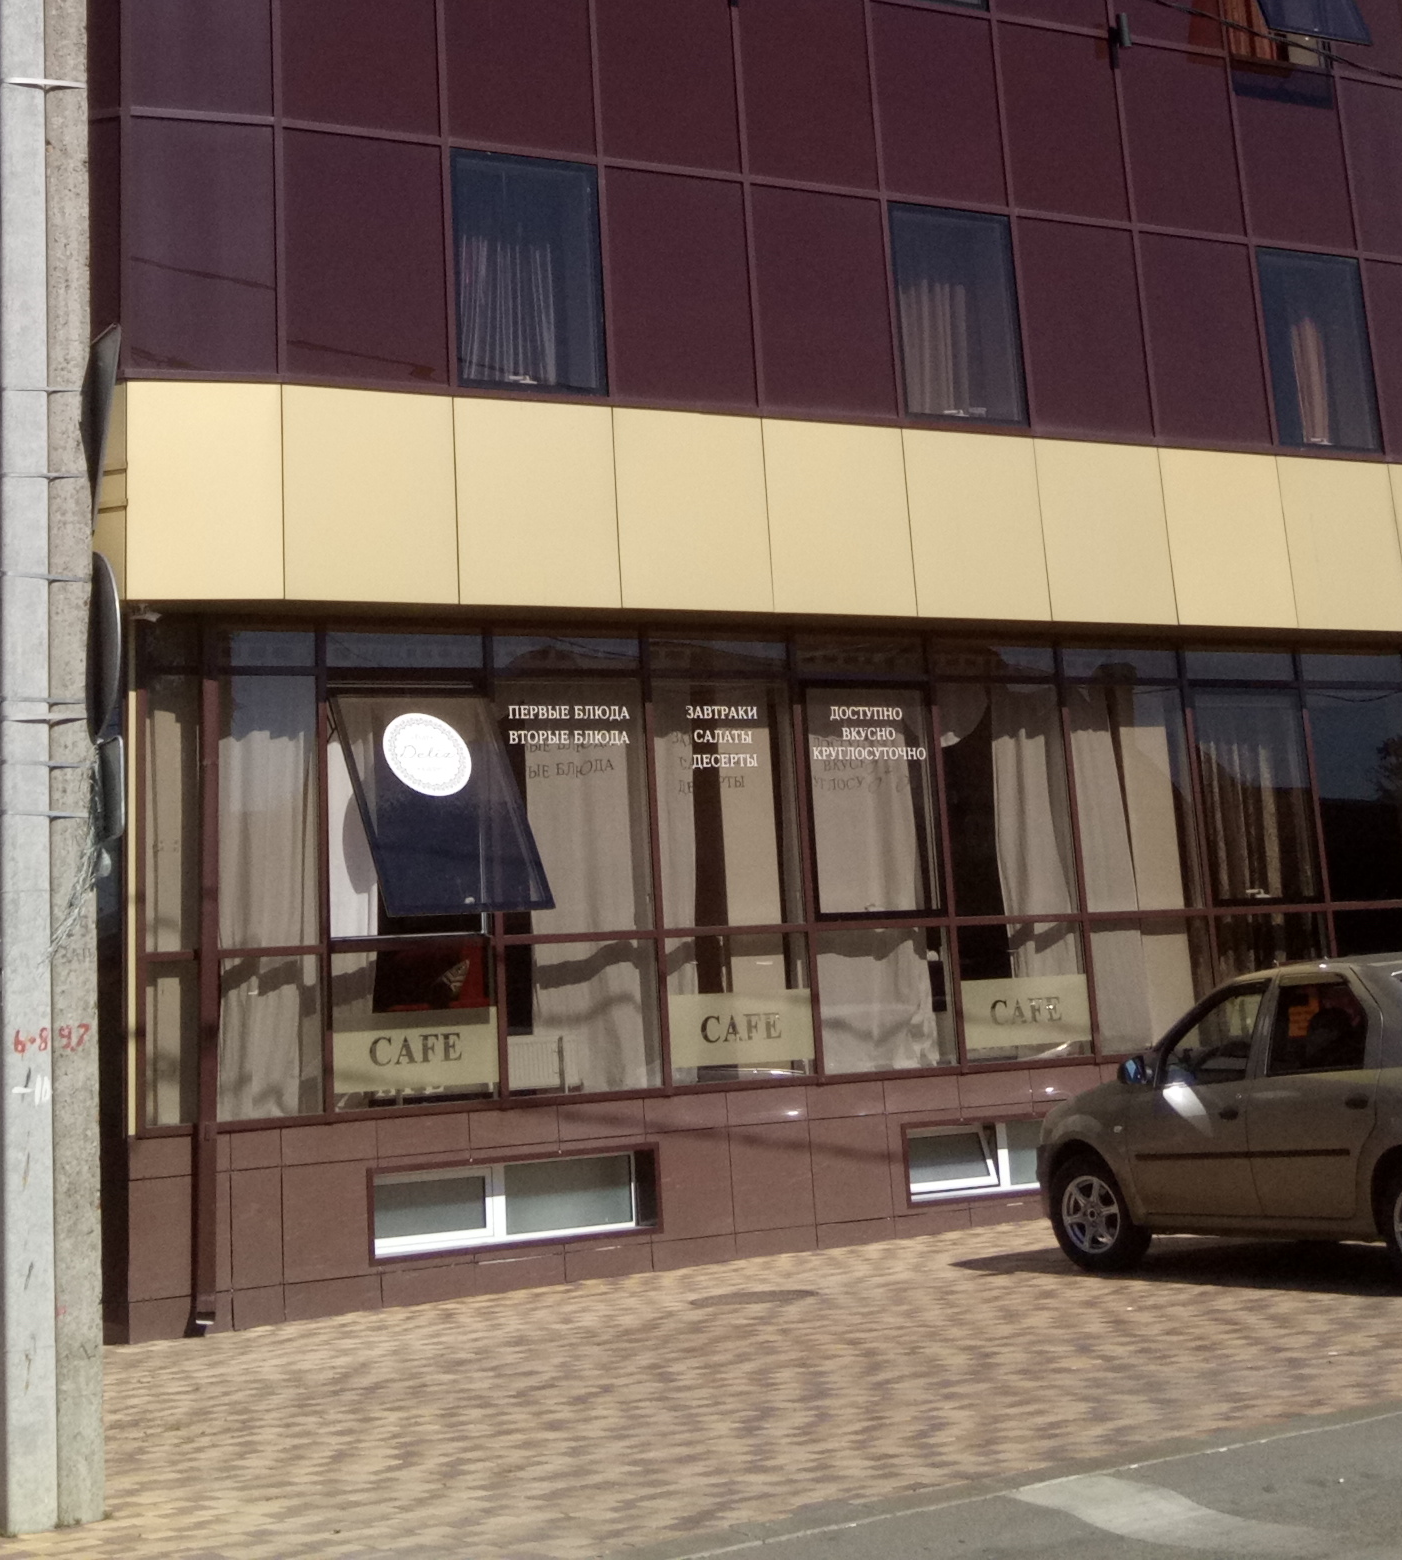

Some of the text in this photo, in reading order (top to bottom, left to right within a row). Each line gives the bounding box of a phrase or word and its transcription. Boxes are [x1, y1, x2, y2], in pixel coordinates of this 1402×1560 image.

[508, 705, 630, 721] ПЕРВЫЕ БЛЮДА
[686, 705, 758, 720] ЗАВТРАКИ
[830, 706, 903, 721] ДОСТУПНО
[508, 730, 630, 746] ВТОРЫЕ БЛЮДА
[694, 729, 753, 744] САЛАТЫ
[842, 727, 896, 741] ВКУСНО
[692, 753, 759, 769] ДЕСЕРТЫ
[812, 746, 927, 761] КРУГЛОСУТОЧНО
[990, 996, 1064, 1027] CAFE
[700, 1011, 784, 1046] CAFE
[369, 1032, 463, 1067] CAFE
